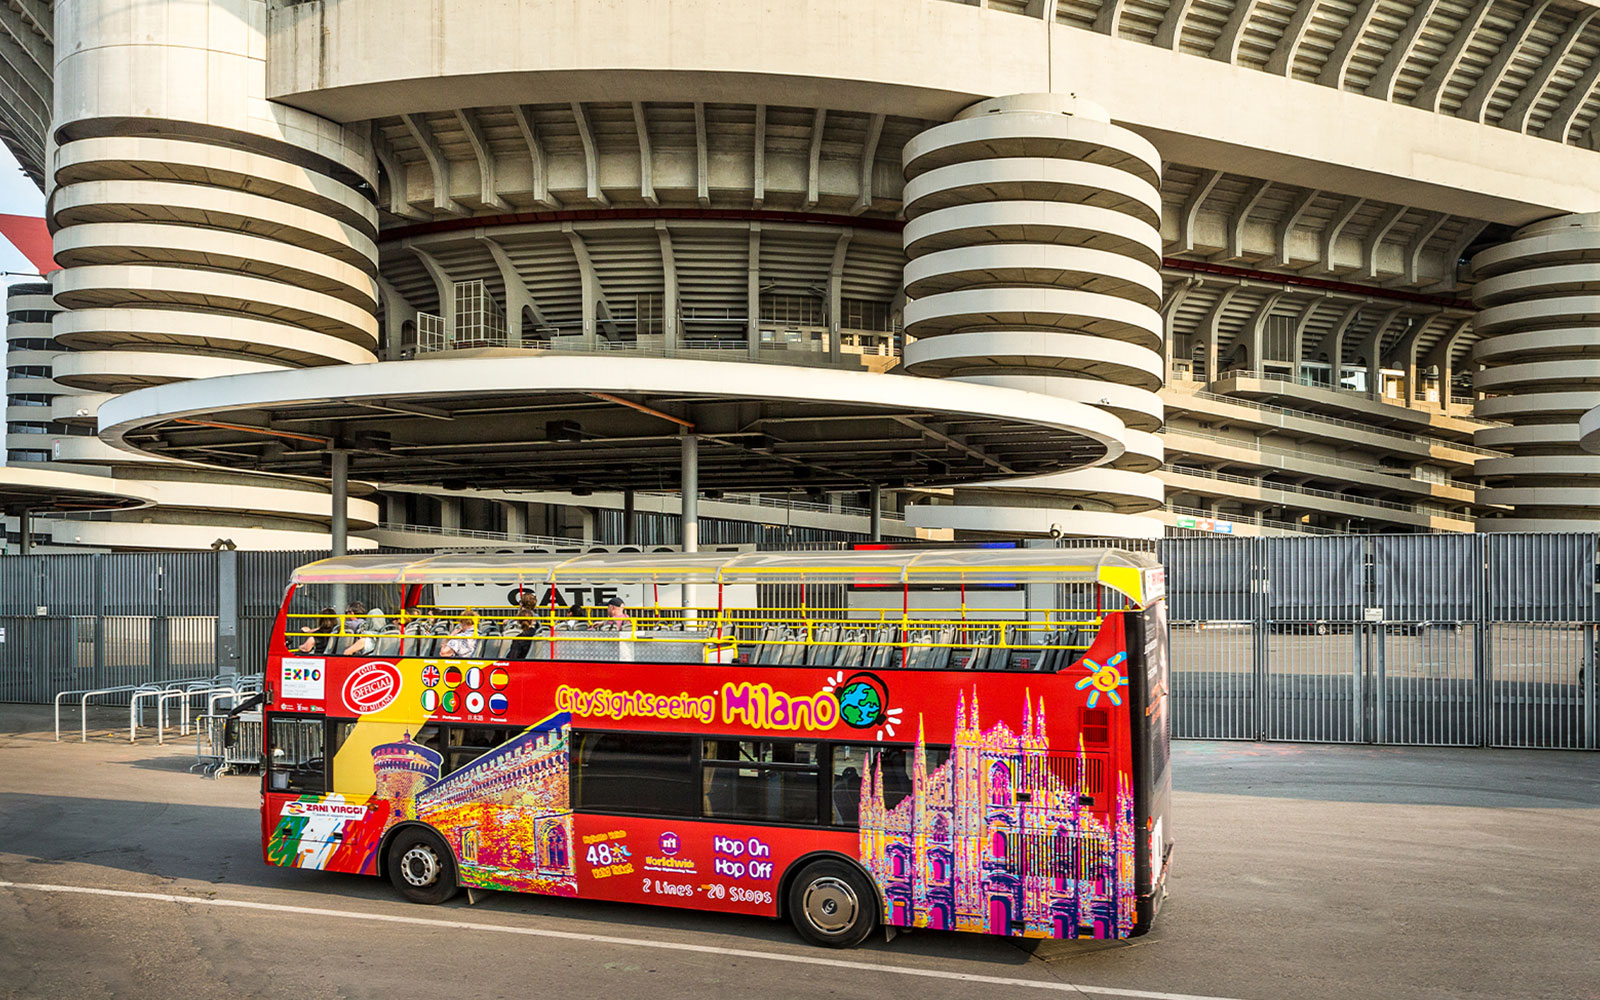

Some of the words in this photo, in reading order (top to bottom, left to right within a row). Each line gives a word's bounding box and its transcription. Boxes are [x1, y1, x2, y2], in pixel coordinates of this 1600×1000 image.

[284, 667, 322, 682] EXPO
[353, 676, 392, 699] OFFICIAL
[556, 685, 714, 723] CitySightseeing
[723, 682, 839, 730] Milano
[306, 803, 329, 813] ZANI
[330, 805, 363, 815] VIAGGI
[586, 843, 613, 866] 48
[714, 836, 745, 857] Hop
[748, 838, 770, 857] On
[714, 858, 745, 879] Hop
[748, 860, 774, 879] Off
[642, 878, 652, 893] 2
[655, 880, 693, 897] Lines
[707, 883, 726, 899] 20
[729, 886, 773, 904] Stops
